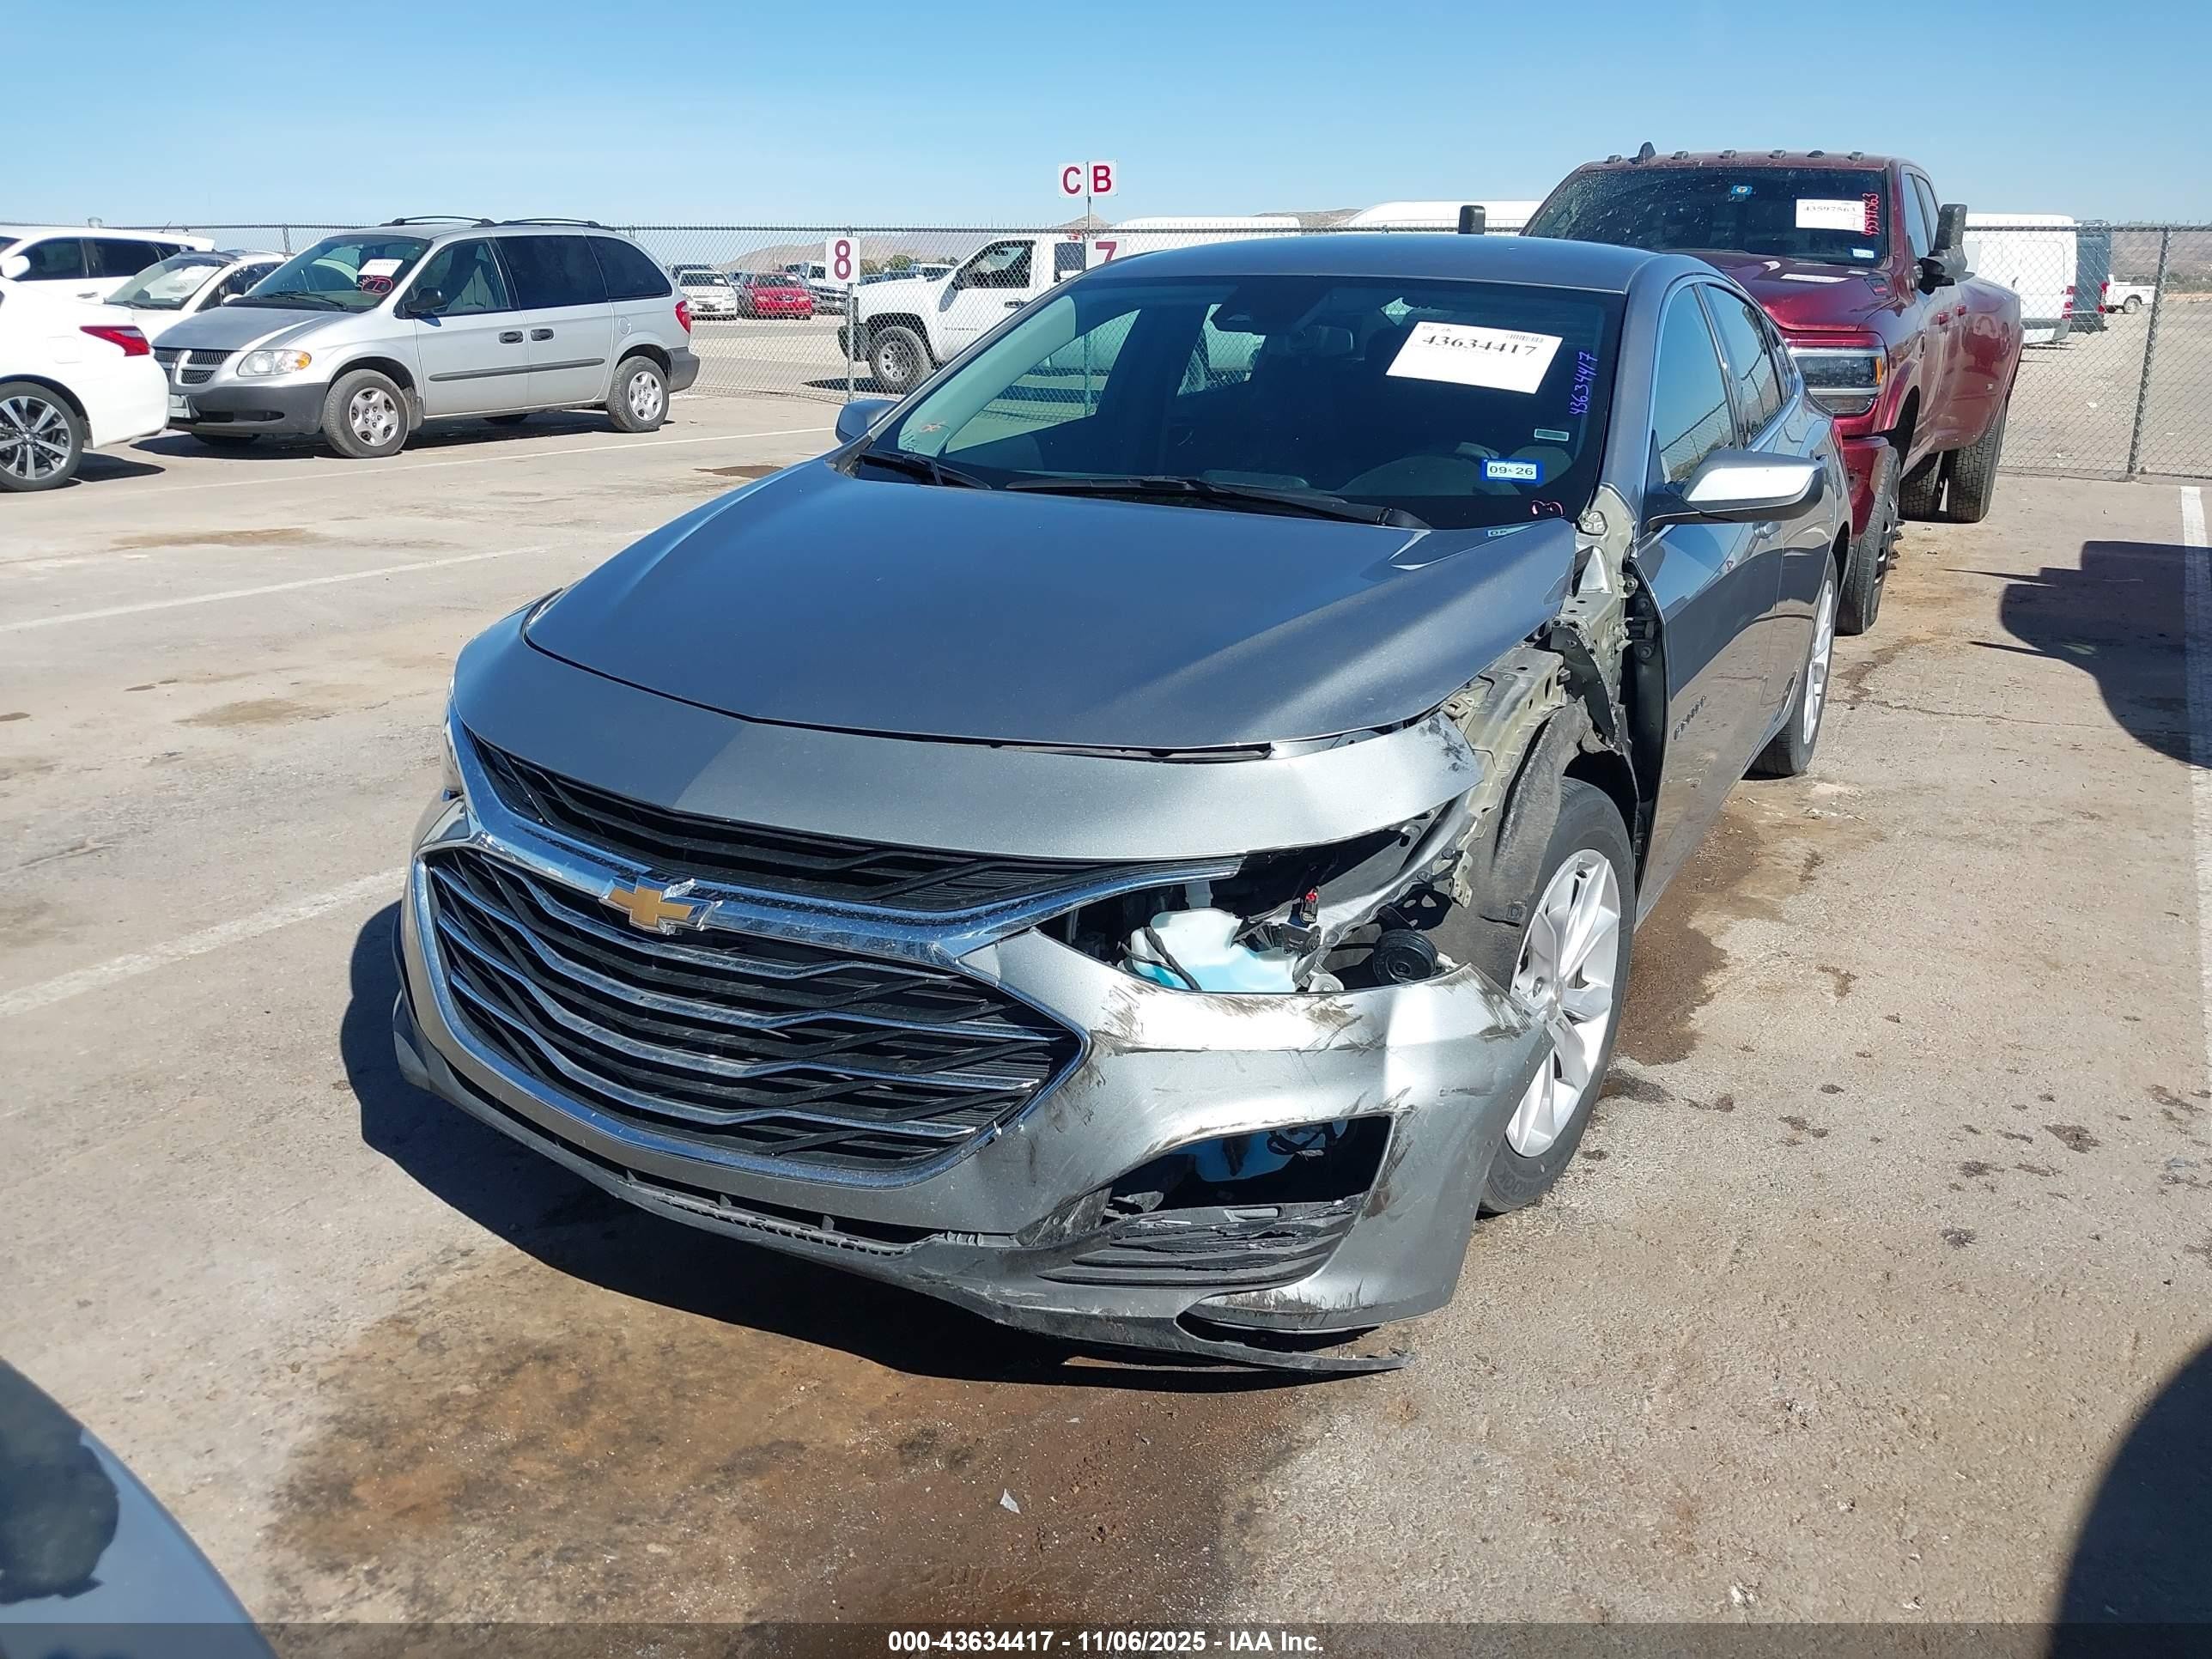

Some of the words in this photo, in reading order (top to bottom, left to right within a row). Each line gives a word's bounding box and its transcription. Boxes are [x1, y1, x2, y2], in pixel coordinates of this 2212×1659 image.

[1063, 166, 1081, 194] C
[1093, 165, 1111, 192] B
[834, 240, 852, 280] 8
[1095, 241, 1117, 263] 7
[1421, 335, 1538, 356] 43634417
